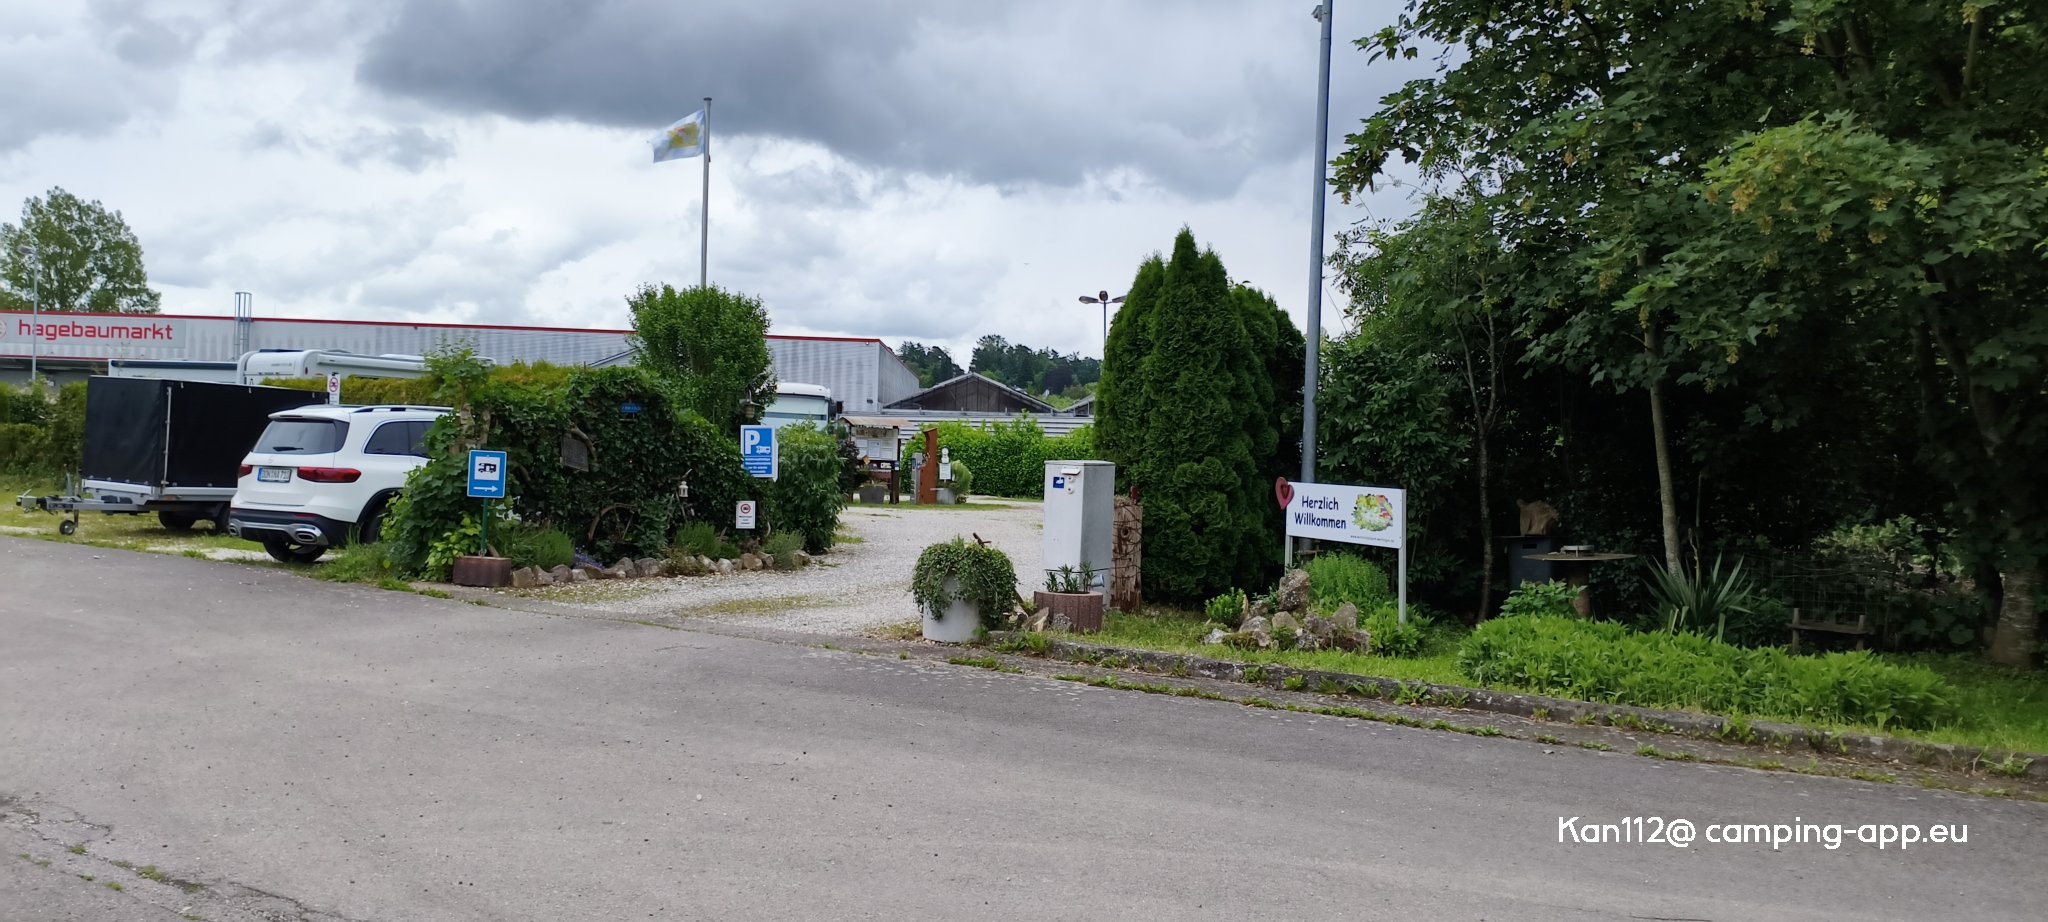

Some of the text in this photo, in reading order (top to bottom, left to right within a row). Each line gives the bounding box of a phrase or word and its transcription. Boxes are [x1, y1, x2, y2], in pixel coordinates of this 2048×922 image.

[18, 319, 173, 341] hagebaumarkt
[745, 430, 760, 455] P
[1301, 495, 1339, 511] Herzlich
[1294, 511, 1346, 529] Willkommen
